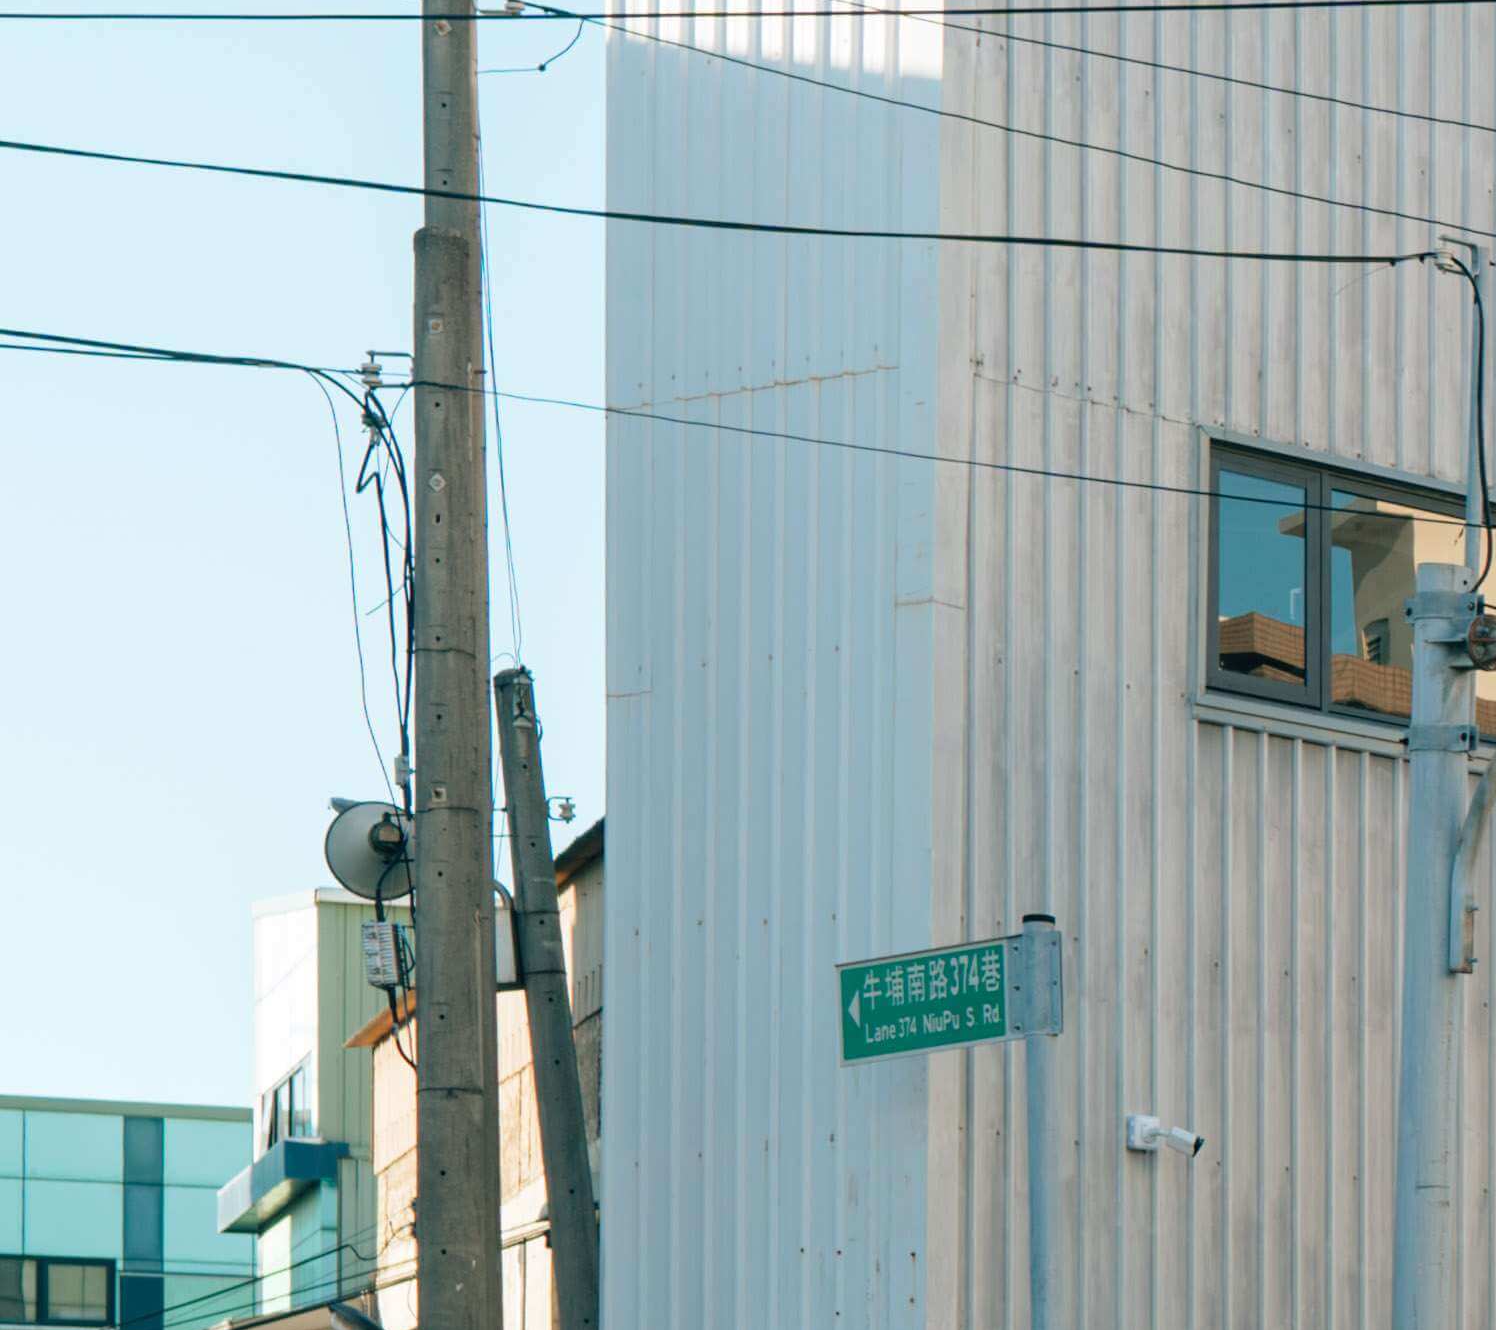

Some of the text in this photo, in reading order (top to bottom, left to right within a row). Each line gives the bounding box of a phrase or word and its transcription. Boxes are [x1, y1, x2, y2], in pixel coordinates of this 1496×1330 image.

[863, 950, 1001, 1010] 牛埔南路374巷
[865, 1003, 1001, 1043] Lane 374 NiuPu S Rd
